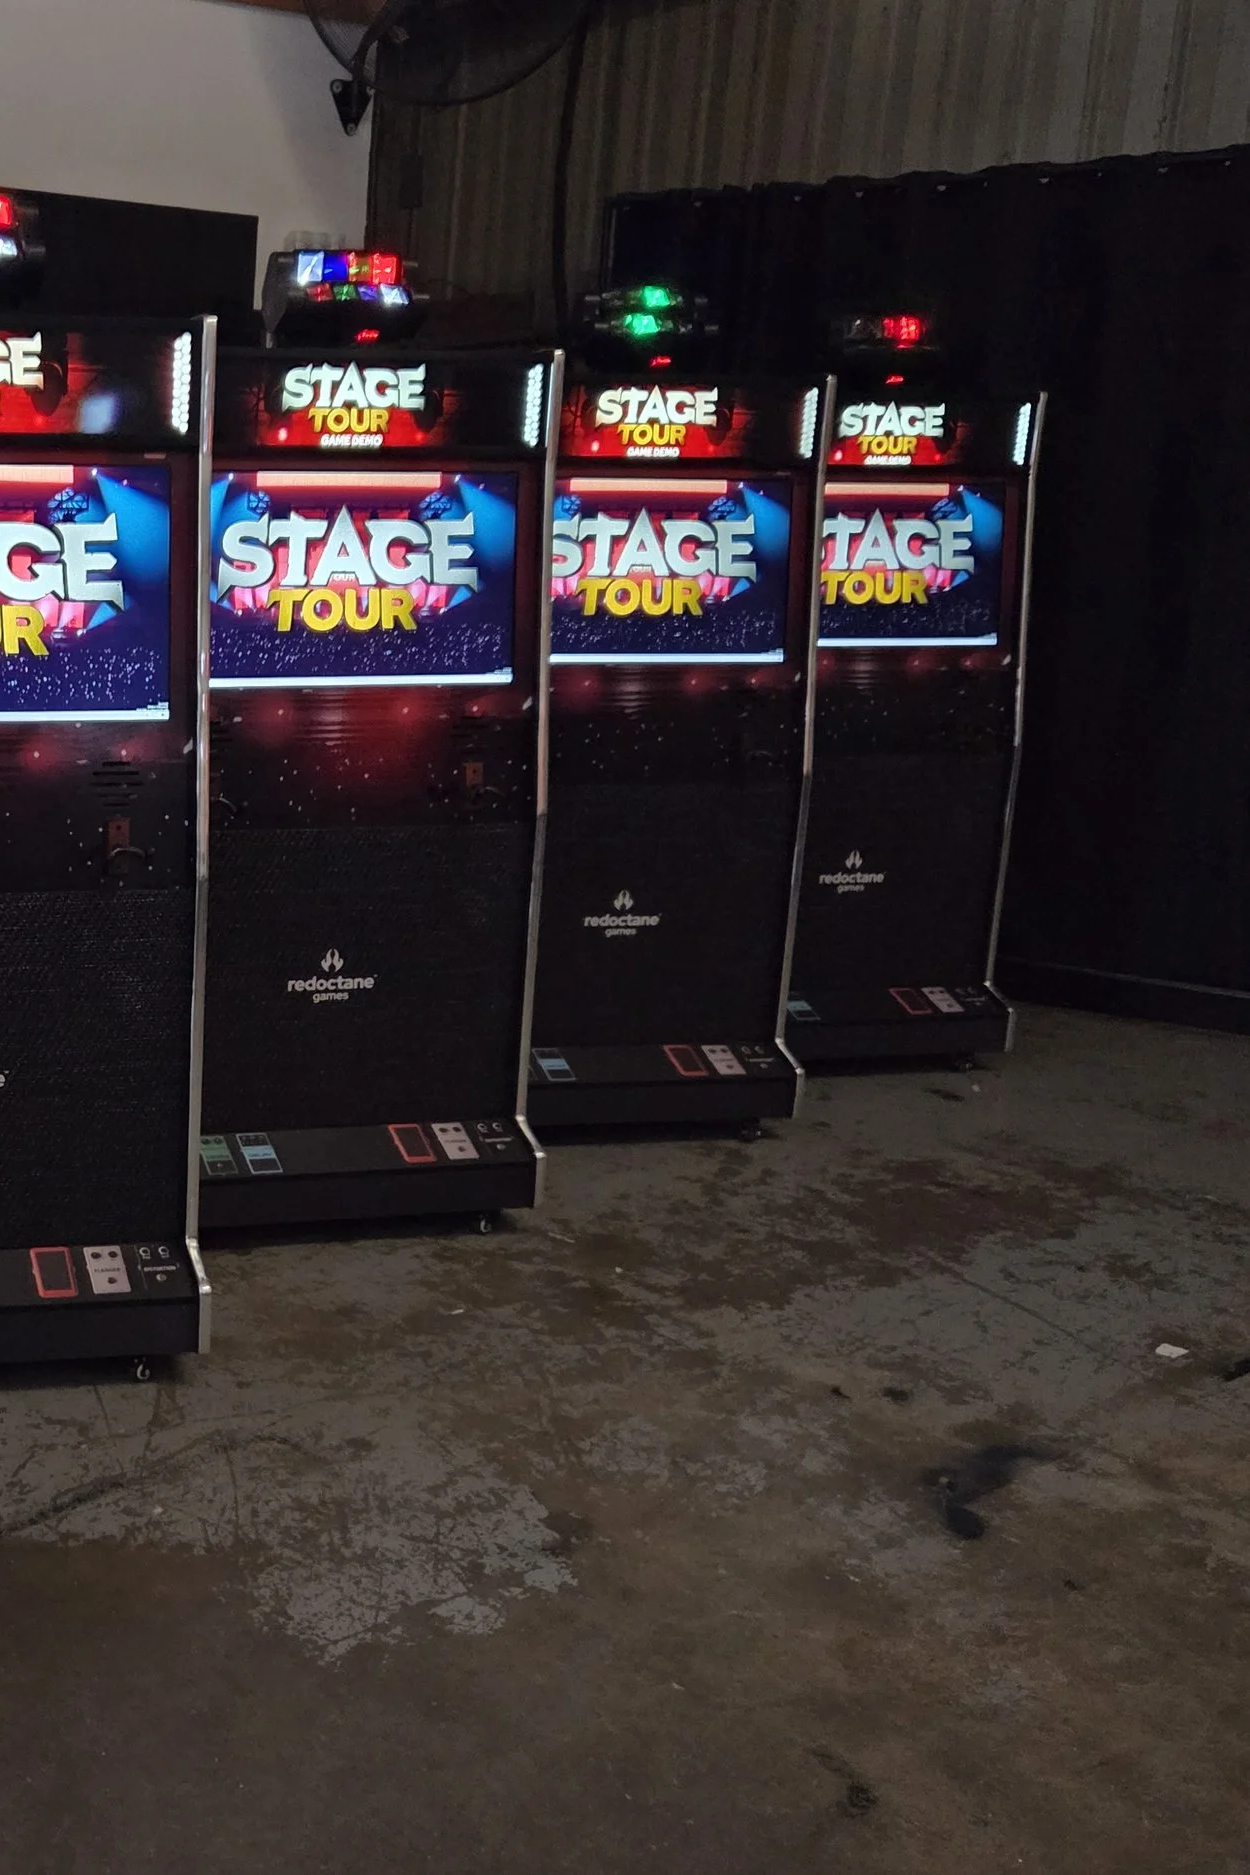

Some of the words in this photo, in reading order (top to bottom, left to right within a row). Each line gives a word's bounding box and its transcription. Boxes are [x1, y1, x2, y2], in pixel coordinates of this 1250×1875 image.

[282, 360, 426, 412] STAGE
[308, 408, 389, 433] TOUR
[595, 384, 718, 427] STAGE
[839, 401, 945, 437] STAGE
[320, 434, 351, 446] GAME
[351, 434, 383, 446] DEMO
[617, 424, 686, 446] TOUR
[857, 435, 918, 455] TOUR
[217, 504, 478, 602] STAGE
[552, 507, 757, 583] STAGE
[822, 508, 974, 575] TAGE
[574, 578, 702, 616] TOUR
[821, 571, 928, 605] TOUR
[266, 588, 417, 632] TOUR
[819, 871, 884, 884] redoctane
[584, 913, 659, 927] redoctane
[287, 976, 375, 992] redoctane
[312, 992, 349, 1004] games
